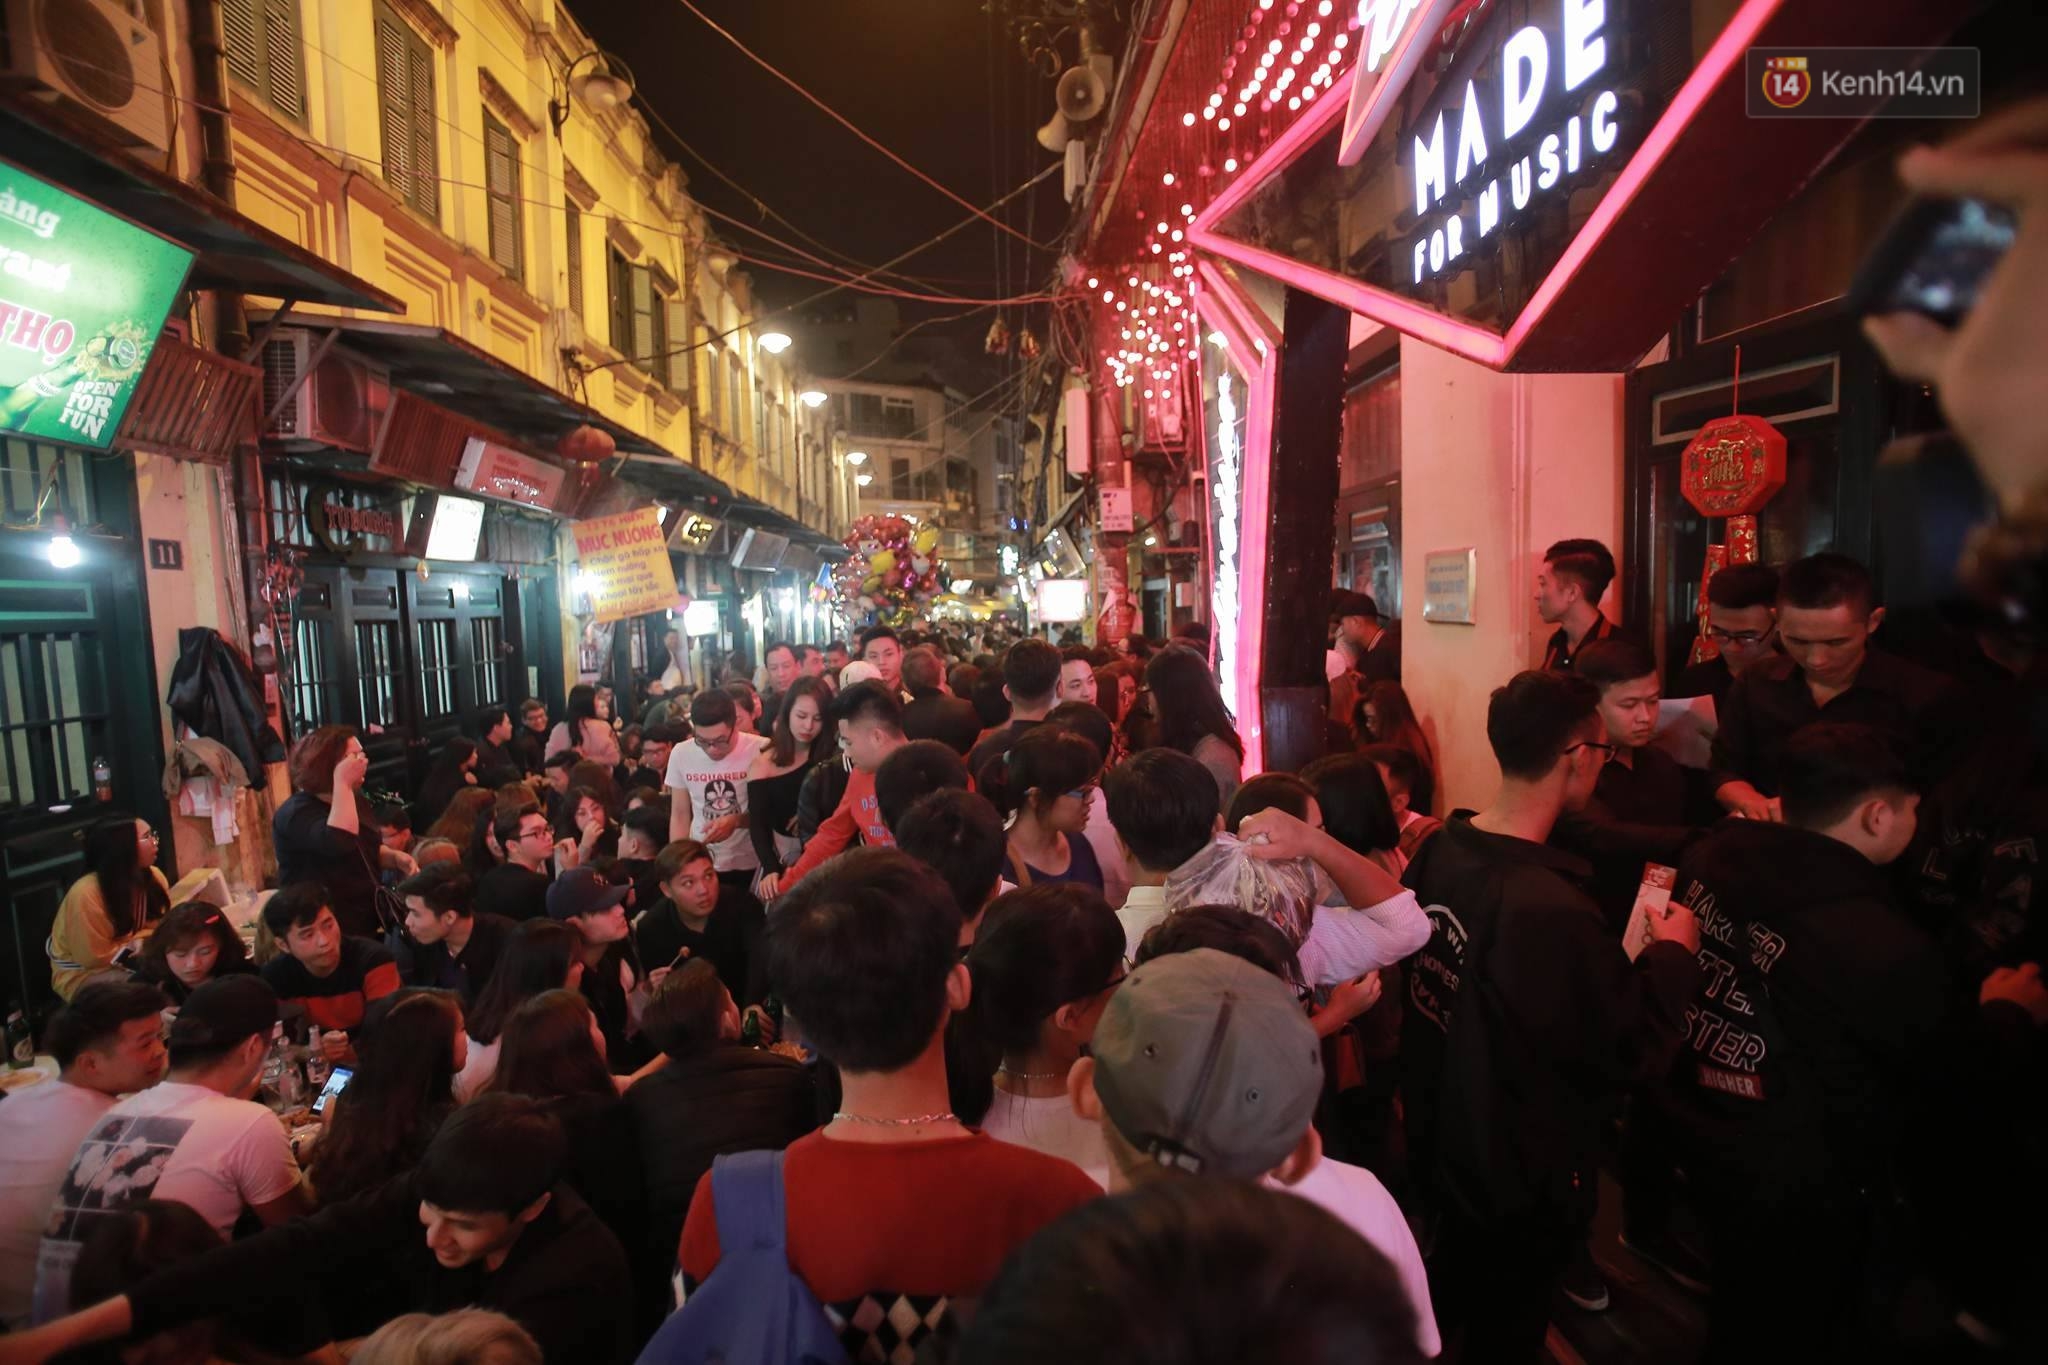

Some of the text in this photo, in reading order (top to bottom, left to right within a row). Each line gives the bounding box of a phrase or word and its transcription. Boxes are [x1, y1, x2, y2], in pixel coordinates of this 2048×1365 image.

[1414, 0, 1605, 216] MADE
[1414, 91, 1617, 284] FOR MUSIC
[73, 381, 121, 397] OPEN
[66, 391, 113, 418] FOR
[58, 407, 107, 440] FUN
[158, 544, 176, 565] 11
[1702, 1068, 1756, 1098] HIGHER
